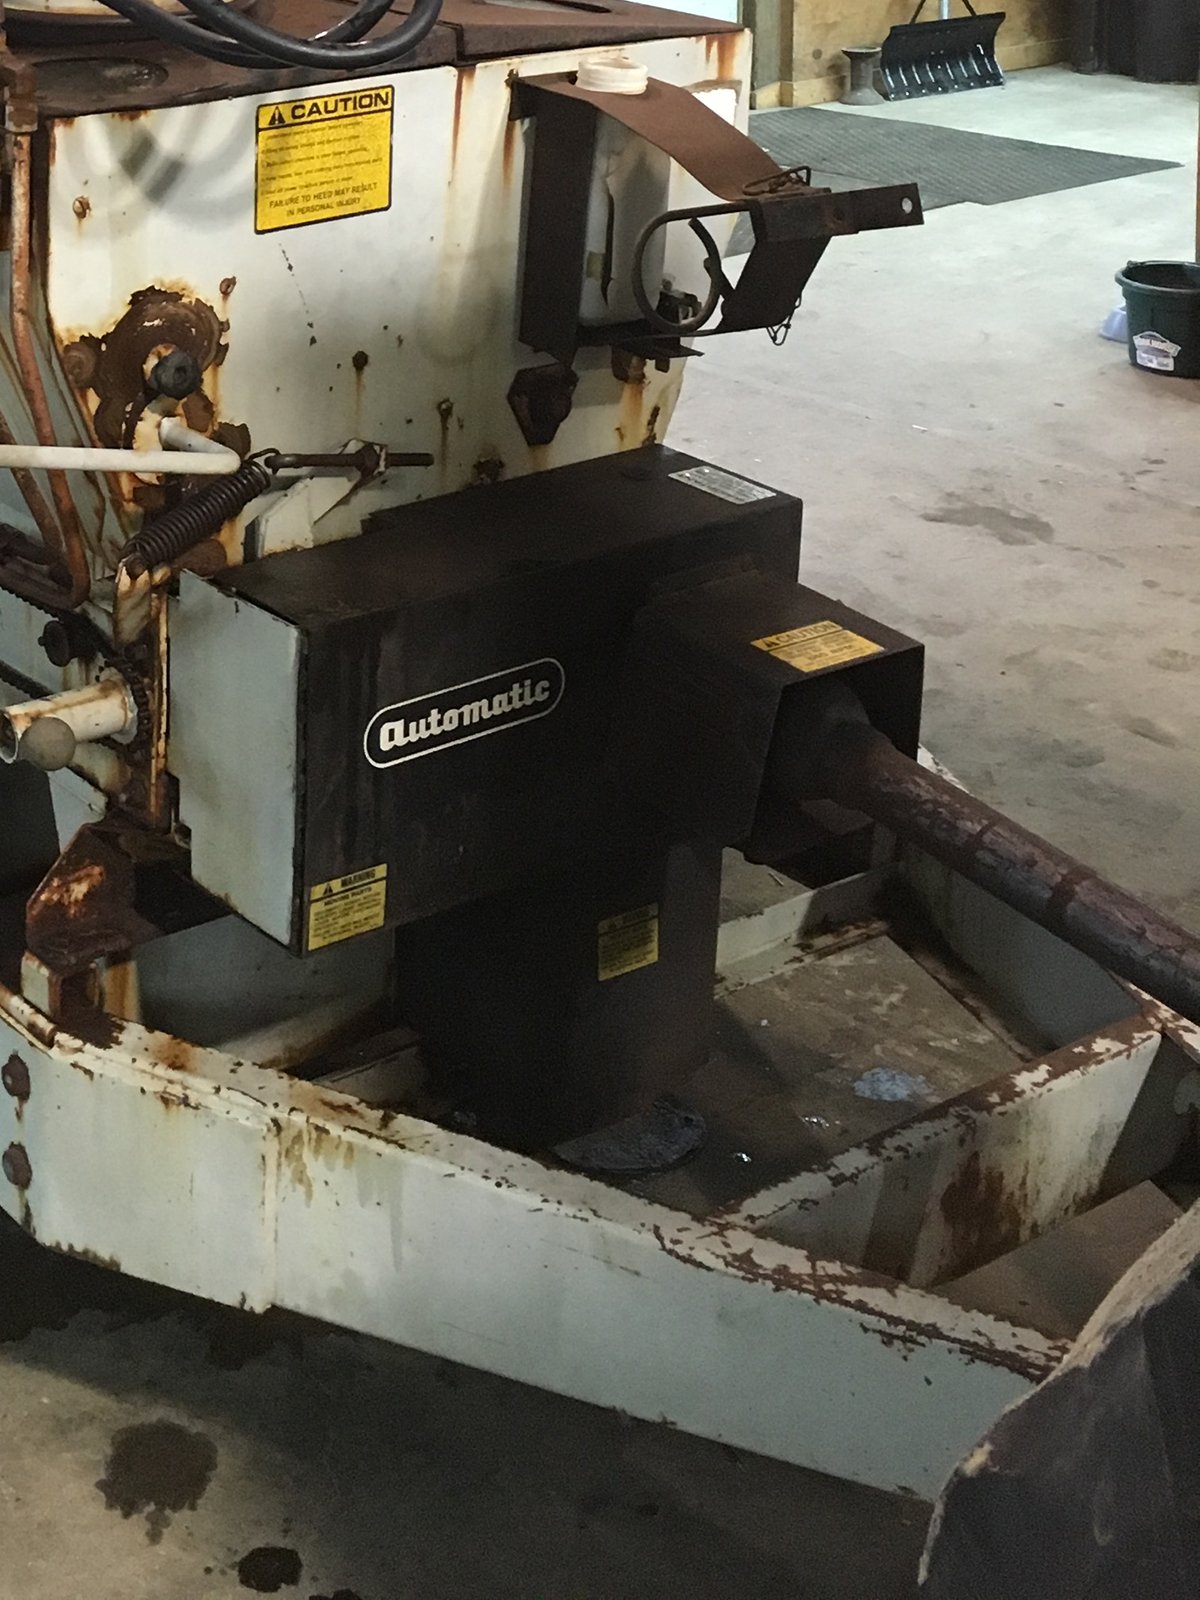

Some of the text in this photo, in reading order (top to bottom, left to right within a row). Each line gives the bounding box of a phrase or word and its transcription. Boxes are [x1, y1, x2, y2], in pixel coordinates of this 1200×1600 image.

[290, 91, 390, 121] CAUTION
[269, 193, 299, 209] FAILURE
[302, 193, 311, 204] TO
[313, 190, 333, 201] HEED
[334, 186, 350, 198] MAY
[351, 181, 378, 194] RESULT
[286, 207, 295, 217] IN
[297, 202, 334, 216] PERSONAL
[776, 621, 837, 642] CAUTION
[341, 869, 376, 887] WARNING
